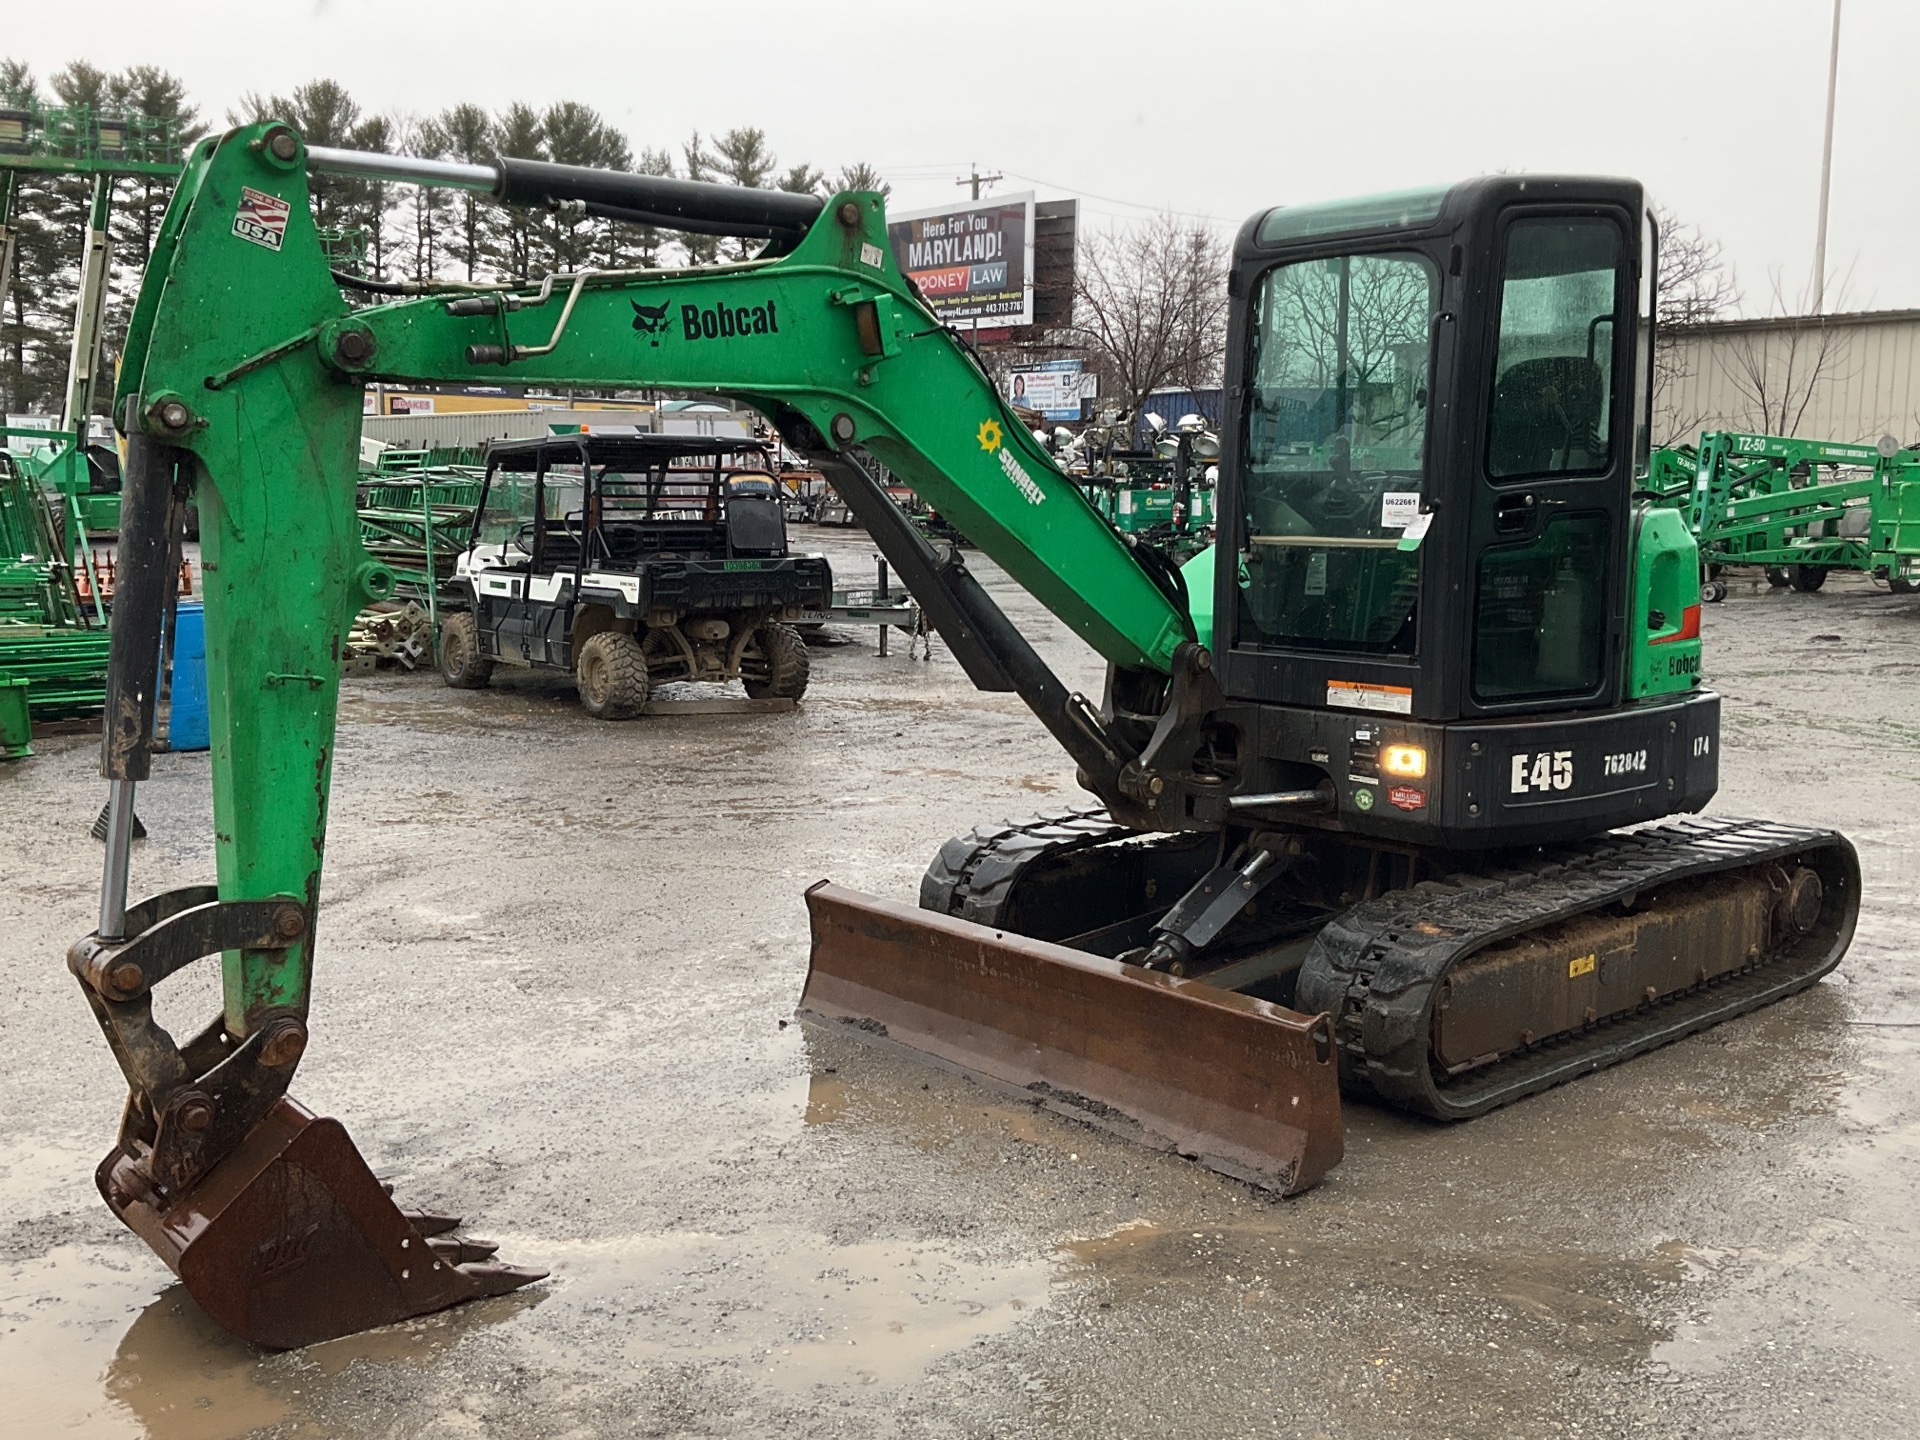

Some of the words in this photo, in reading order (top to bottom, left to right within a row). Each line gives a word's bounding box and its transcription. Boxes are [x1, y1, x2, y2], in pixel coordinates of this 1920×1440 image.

[244, 189, 264, 202] MADE
[265, 197, 273, 206] IN
[274, 201, 287, 210] THE
[236, 219, 278, 246] USA
[922, 220, 946, 239] Here
[948, 217, 966, 235] For
[968, 214, 988, 232] You
[908, 231, 1002, 268] MARYLAND!
[972, 268, 1003, 285] LAW
[681, 299, 779, 341] Bobcat
[393, 399, 430, 410] BRAKES
[1739, 436, 1766, 452] TZ-50
[999, 447, 1046, 506] SUNBELT
[1511, 750, 1573, 794] E45
[1604, 750, 1647, 776] 762842
[1395, 791, 1421, 801] MILLION
